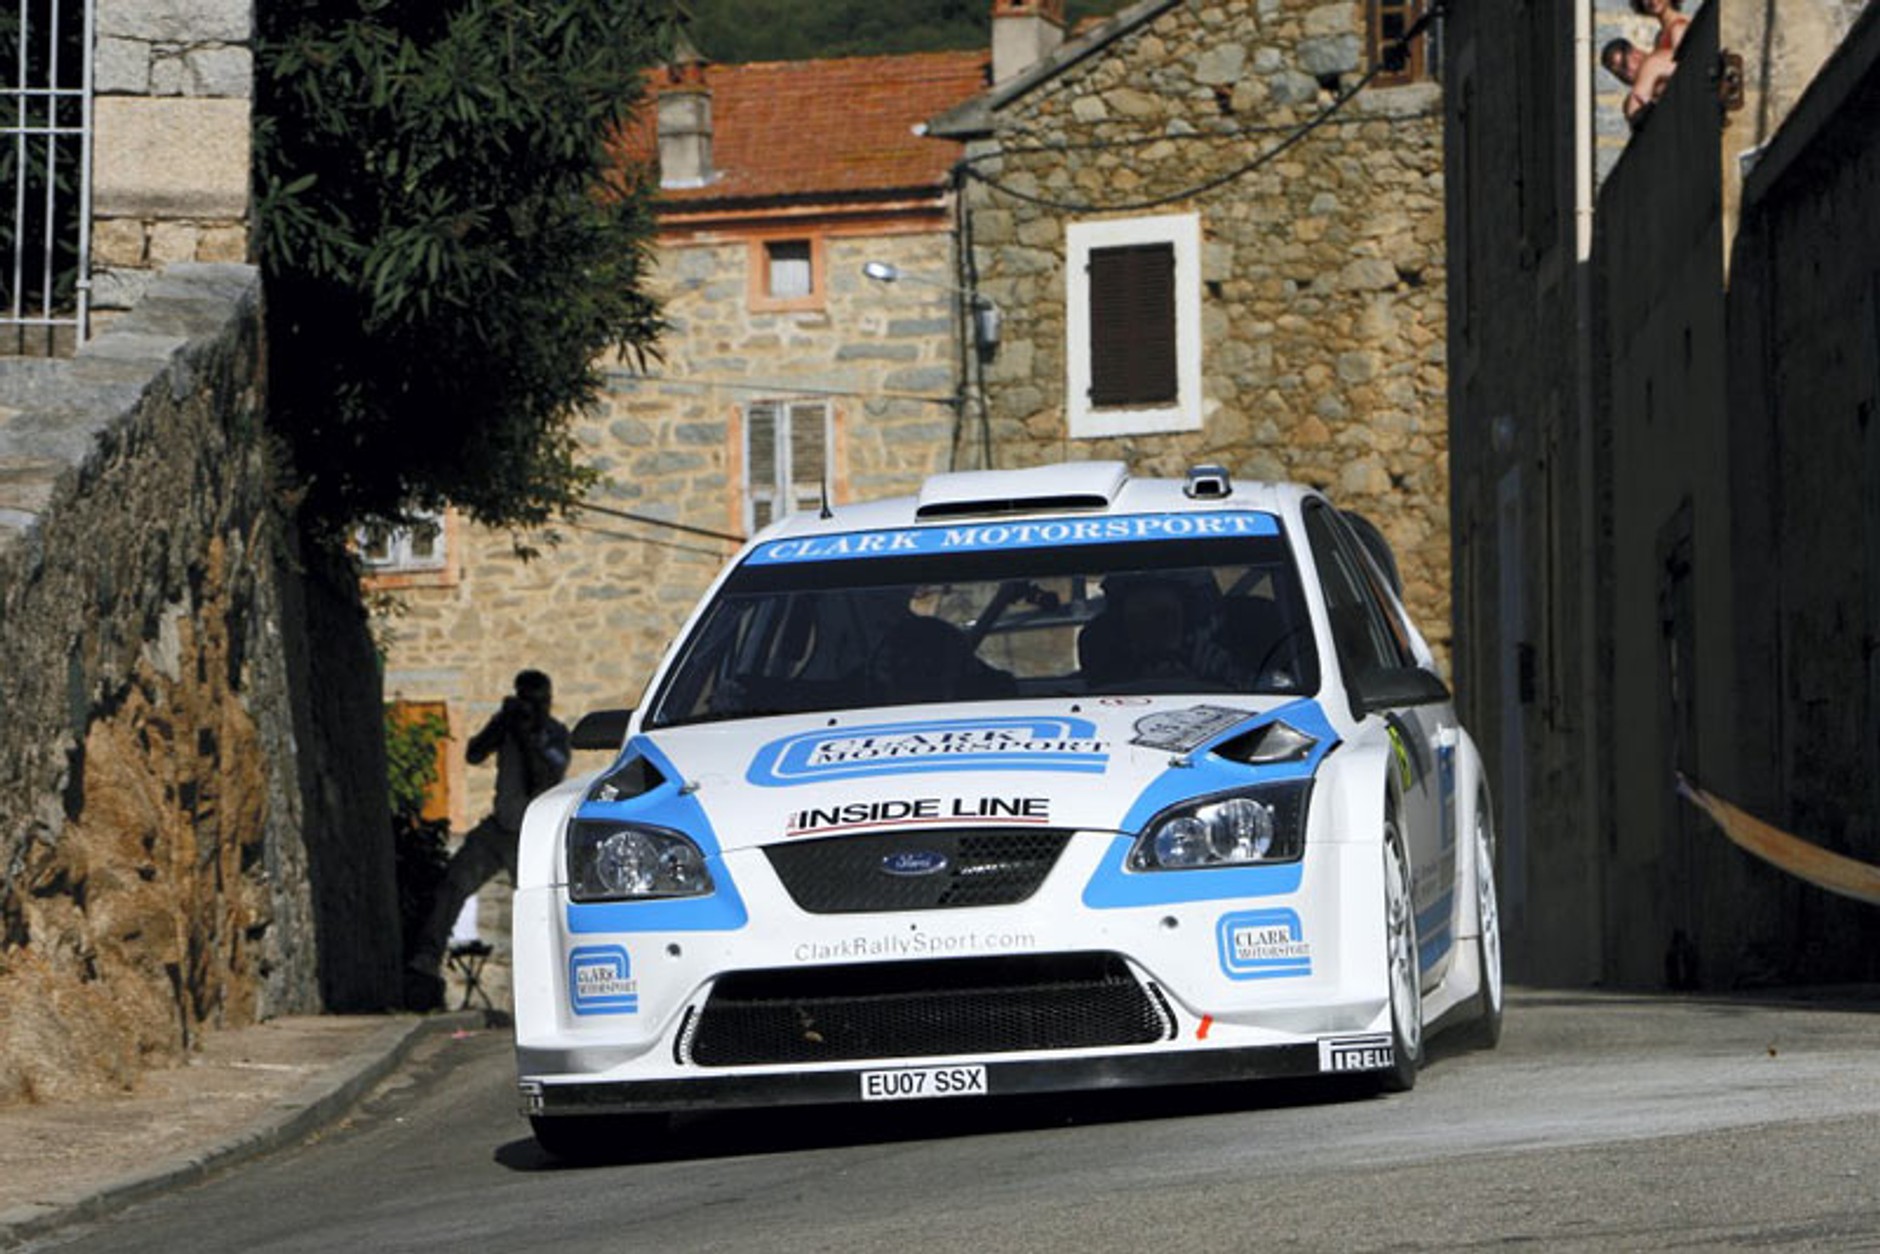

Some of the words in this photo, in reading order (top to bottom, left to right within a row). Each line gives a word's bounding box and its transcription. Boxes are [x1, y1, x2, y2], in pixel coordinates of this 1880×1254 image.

[768, 531, 922, 559] CLARK
[940, 516, 1254, 546] MOTORSPORT
[816, 739, 1111, 764] MOTORSPORT
[818, 729, 1017, 753] CLARK
[798, 798, 941, 829] INSIDE
[952, 797, 1051, 817] LINE
[794, 931, 1036, 963] ClarkRallySport.com
[1235, 929, 1289, 947] CLARK
[867, 1072, 927, 1096] EU07
[935, 1067, 982, 1093] SSX
